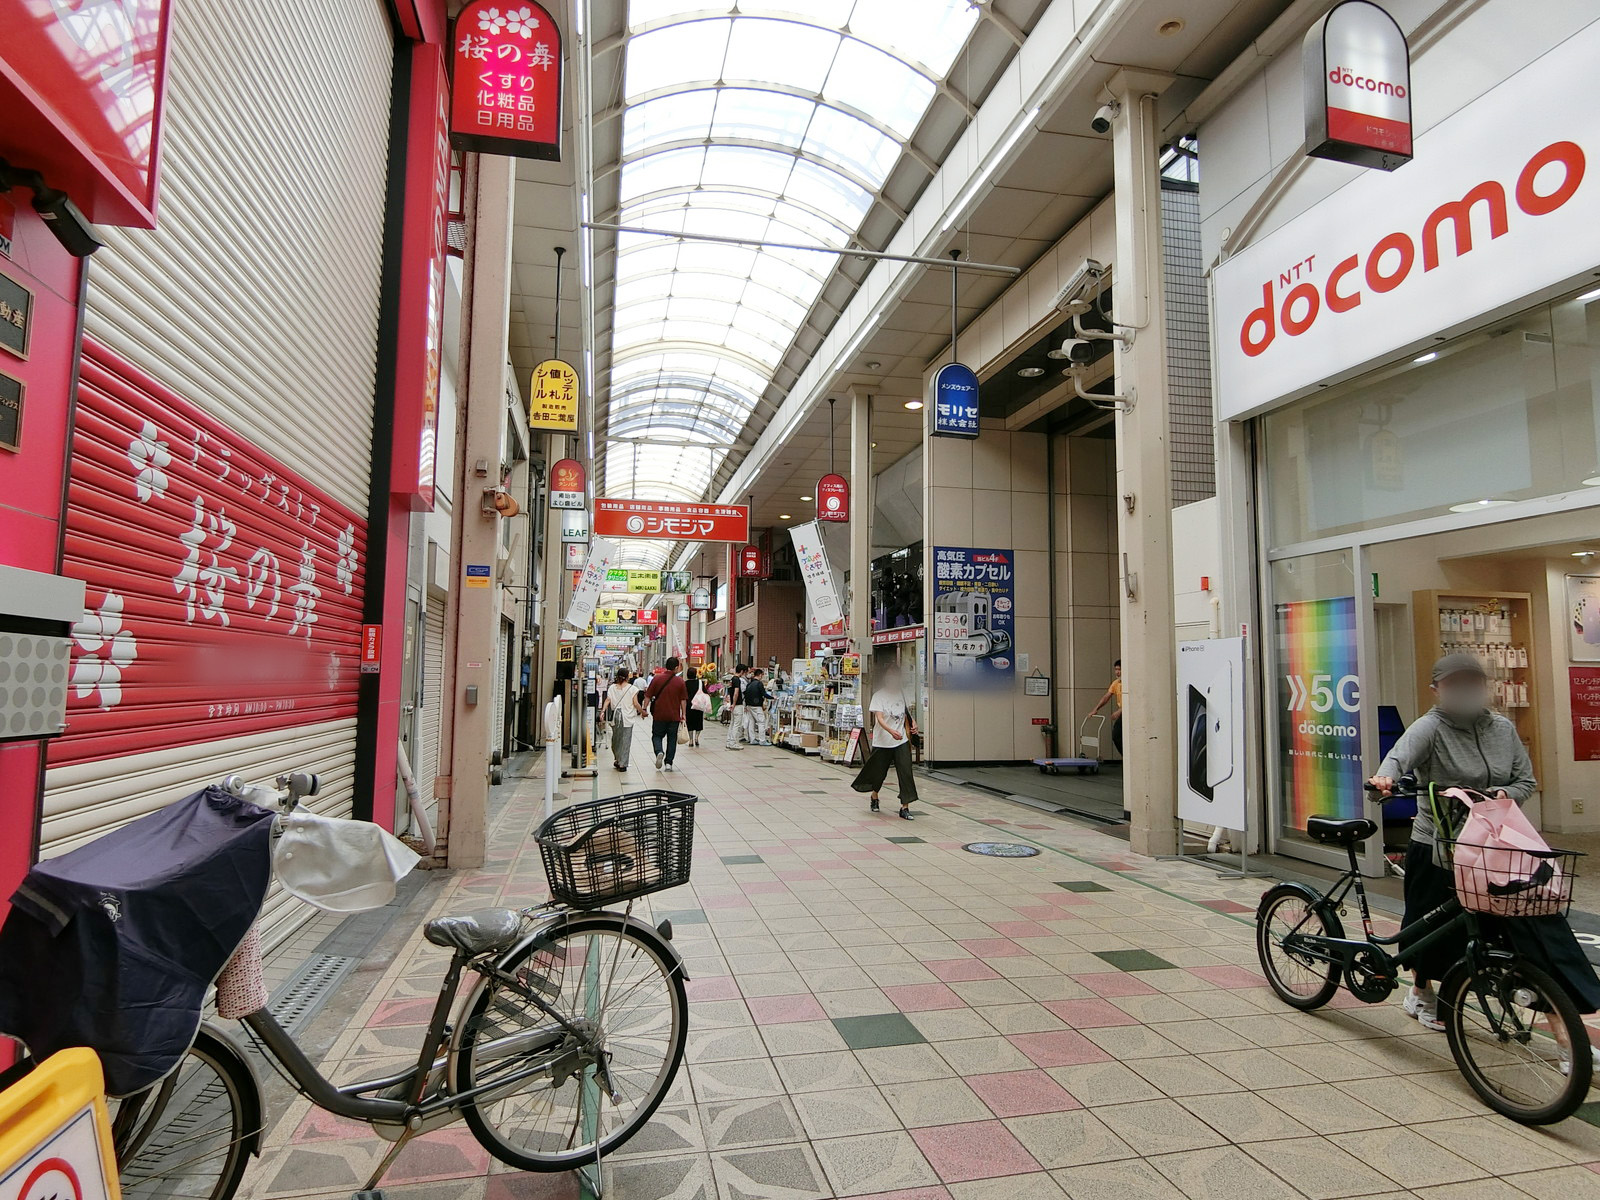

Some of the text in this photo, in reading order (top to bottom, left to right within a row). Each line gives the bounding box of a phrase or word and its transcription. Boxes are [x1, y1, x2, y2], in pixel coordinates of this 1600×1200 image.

[458, 33, 555, 72] 桜の舞
[479, 71, 535, 91] くすり
[1329, 66, 1406, 98] docomo
[477, 90, 535, 112] 化粧品
[477, 110, 535, 132] 日用品
[1240, 140, 1586, 357] docomo
[1279, 255, 1316, 289] NTT
[536, 368, 548, 399] シール
[562, 370, 574, 401] レッテル
[937, 404, 978, 418] モリセ
[937, 417, 978, 428] 株式会社
[193, 430, 321, 527] ドラッグストア
[647, 516, 715, 536] シモジマ
[821, 511, 846, 519] シモジマ
[563, 528, 588, 537] LEAF
[937, 550, 966, 561] 高気圧
[173, 495, 322, 650] 桜の舞
[936, 562, 1011, 581] 酸素カプセル
[937, 627, 968, 638] 500円
[1310, 674, 1361, 713] 5G
[1298, 720, 1357, 737] docomo
